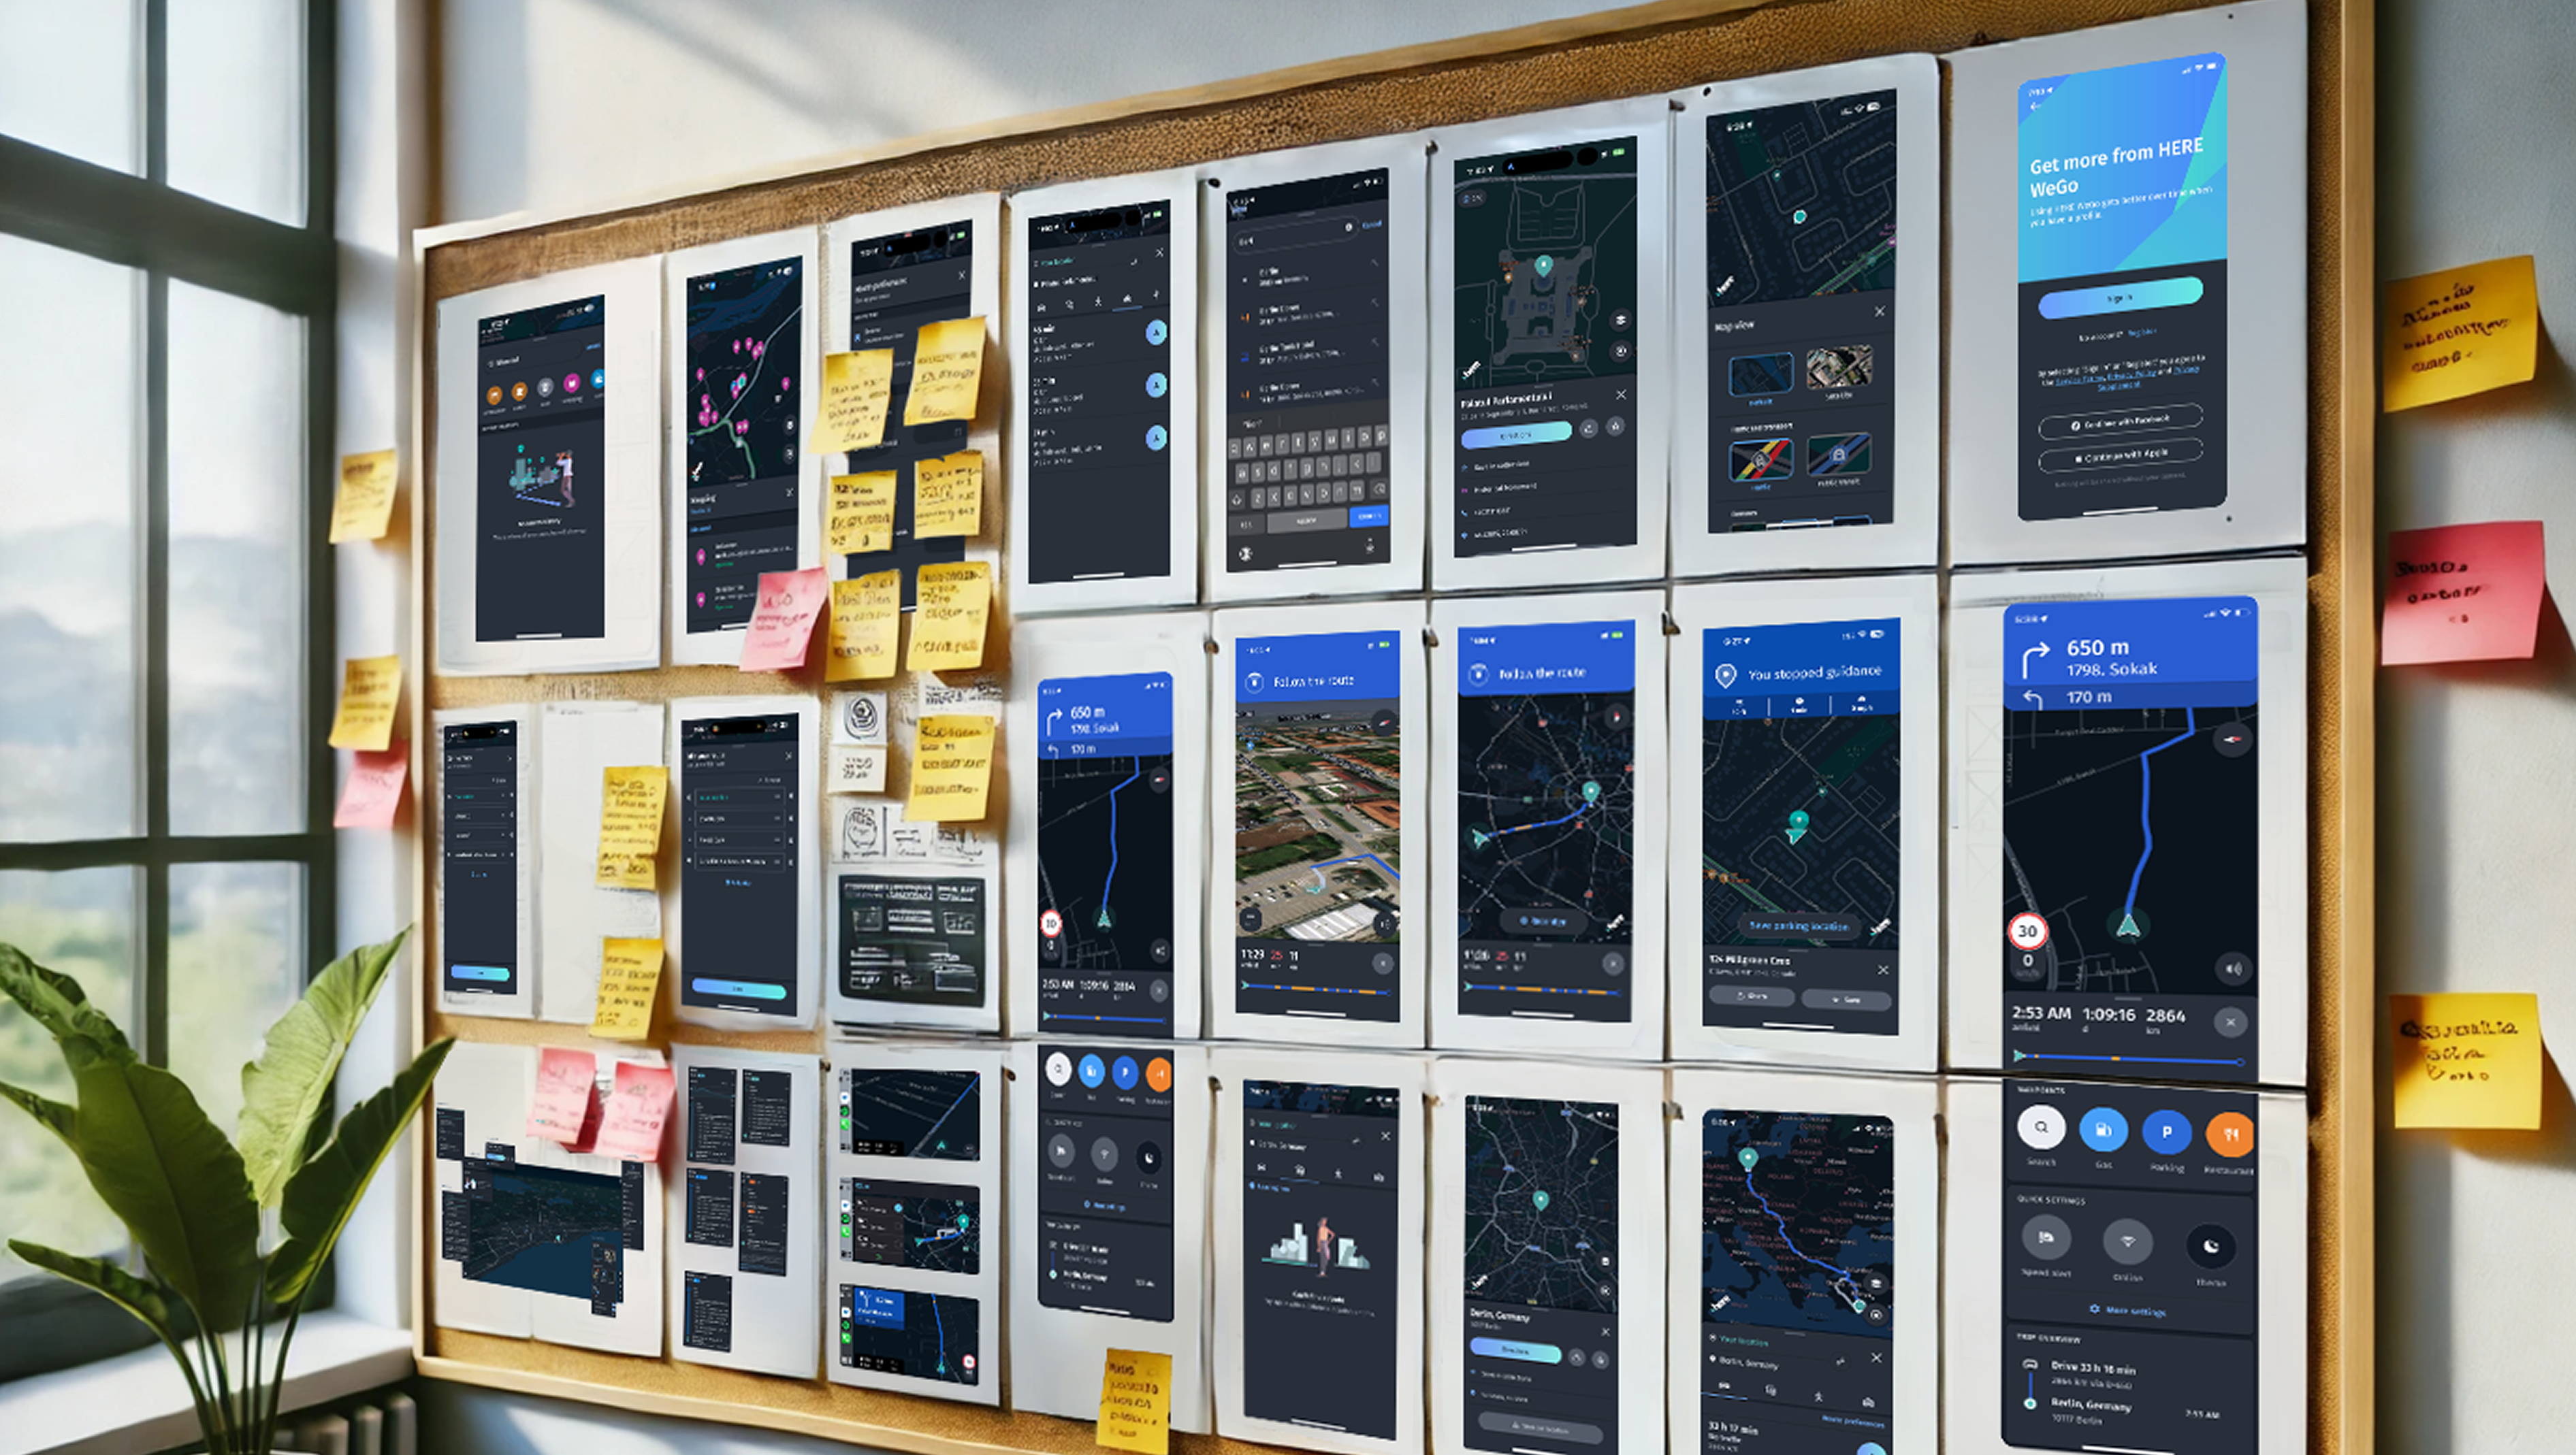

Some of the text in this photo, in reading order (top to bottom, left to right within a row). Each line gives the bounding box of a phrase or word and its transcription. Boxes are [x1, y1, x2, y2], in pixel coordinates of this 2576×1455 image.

[2030, 137, 2204, 175] Get more from HERE
[2030, 179, 2079, 198] WeGo
[2067, 639, 2129, 657] 650 m
[1748, 665, 1882, 681] You stopped guidance
[2067, 662, 2158, 677] 1798. Sokak
[2066, 691, 2112, 704] 170 m
[2018, 926, 2038, 938] 30
[2023, 955, 2033, 967] 0
[2012, 1007, 2187, 1024] 2:53 AM 1:09:16 2864
[2131, 1307, 2167, 1319] settings
[2051, 1361, 2078, 1373] Drive
[2116, 1364, 2137, 1375] min
[2087, 1399, 2132, 1414] Germany
